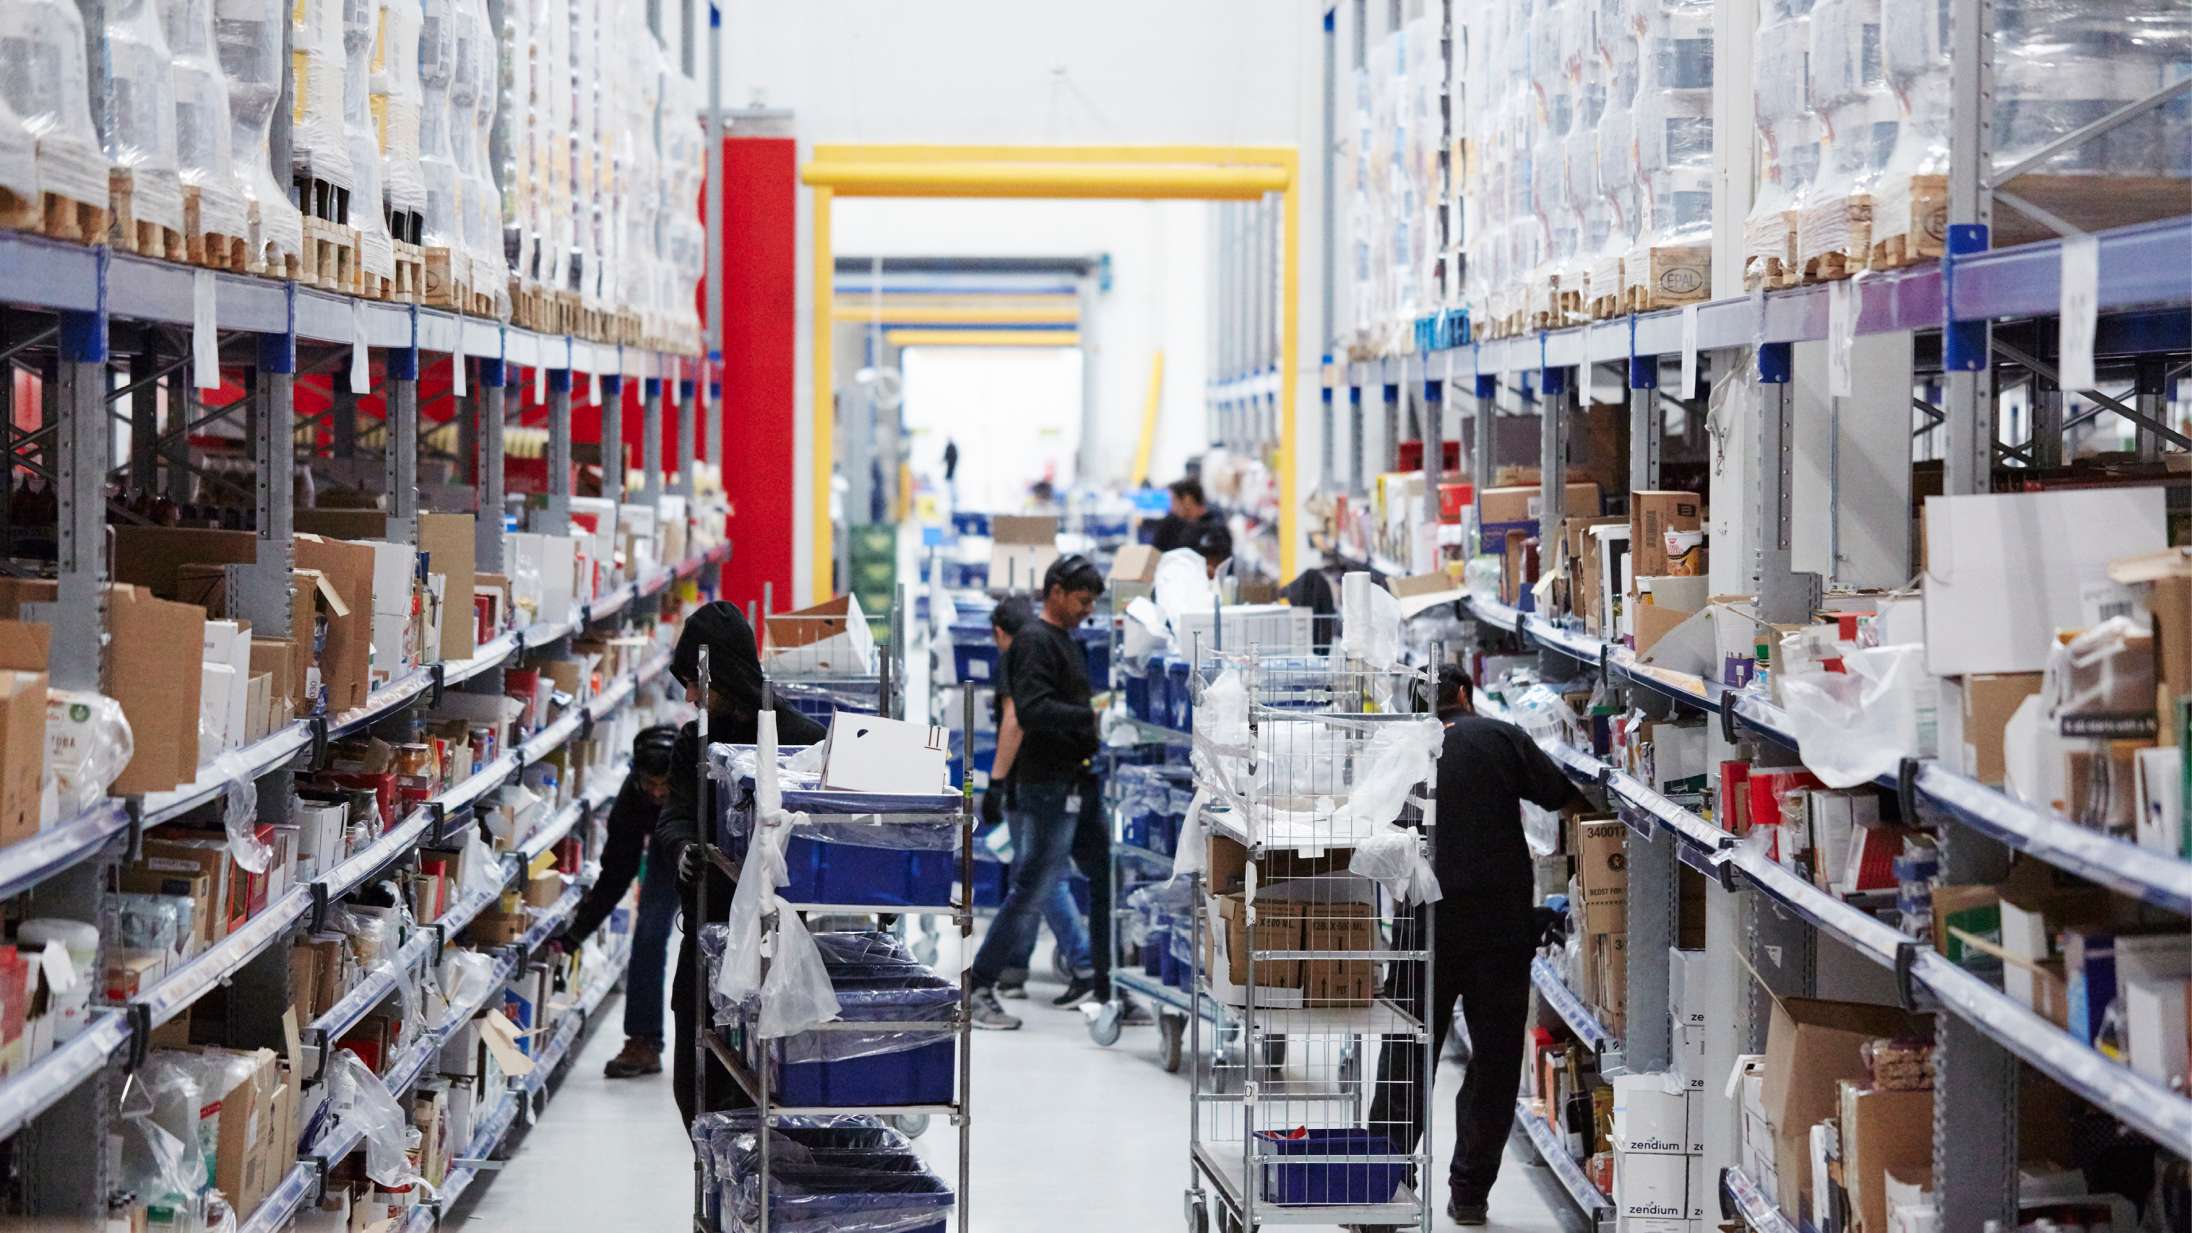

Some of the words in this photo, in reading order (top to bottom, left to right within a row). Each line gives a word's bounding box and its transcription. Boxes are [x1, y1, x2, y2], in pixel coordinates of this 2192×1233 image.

[1667, 273, 1697, 289] EPAL
[1587, 826, 1626, 838] 340017
[1691, 1079, 1705, 1087] ze
[1631, 1140, 1680, 1150] zendium
[1629, 1205, 1679, 1215] zendium
